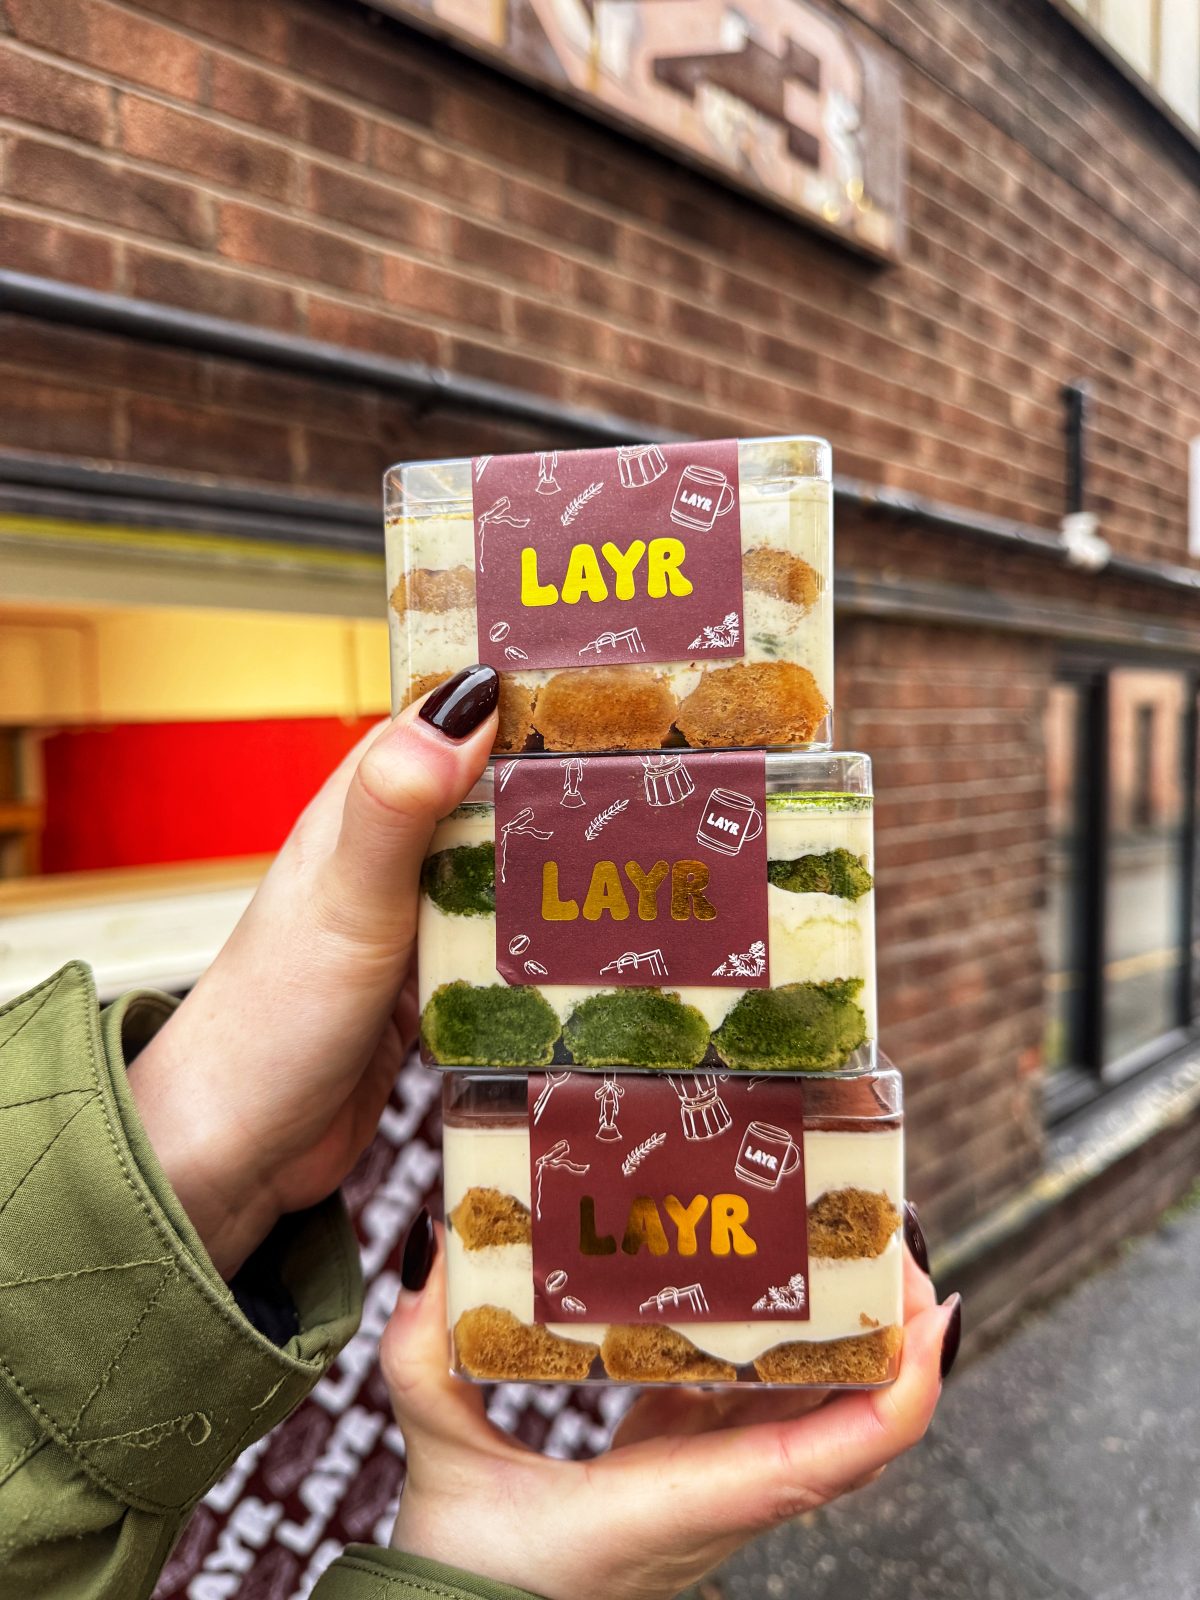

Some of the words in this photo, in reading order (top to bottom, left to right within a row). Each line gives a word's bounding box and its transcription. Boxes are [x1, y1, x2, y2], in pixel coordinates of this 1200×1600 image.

[680, 490, 713, 512] LAYR
[520, 538, 693, 607] LAYR
[706, 812, 740, 836] LAYR
[541, 860, 717, 921] LAYR
[744, 1145, 779, 1170] LAYR
[580, 1193, 757, 1256] LAYR
[273, 1405, 386, 1555] LAYR
